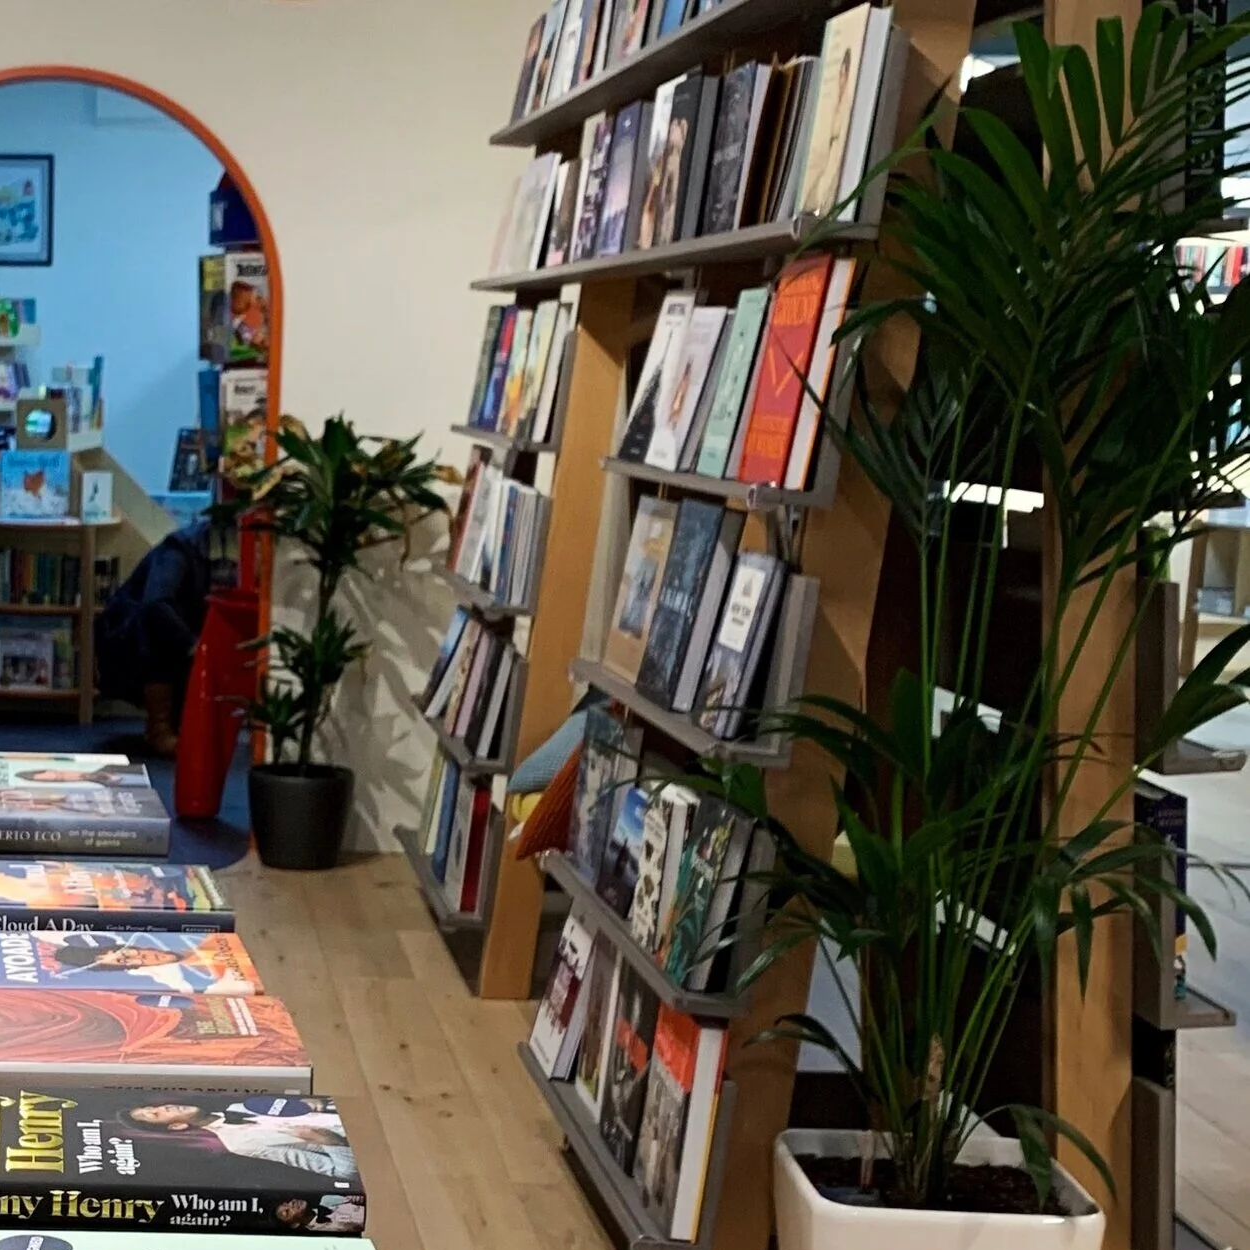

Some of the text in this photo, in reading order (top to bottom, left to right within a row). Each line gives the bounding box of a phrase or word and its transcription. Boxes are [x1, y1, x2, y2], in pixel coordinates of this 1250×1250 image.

[33, 830, 62, 842] ECO
[46, 918, 62, 931] A
[62, 918, 95, 932] Day
[1, 931, 39, 983] AYOADE
[6, 1090, 78, 1173] Henry
[77, 1149, 102, 1176] Who
[107, 1137, 142, 1177] again?
[50, 1189, 165, 1223] Henry
[170, 1193, 214, 1211] Who
[217, 1198, 248, 1212] am
[170, 1213, 232, 1228] again?
